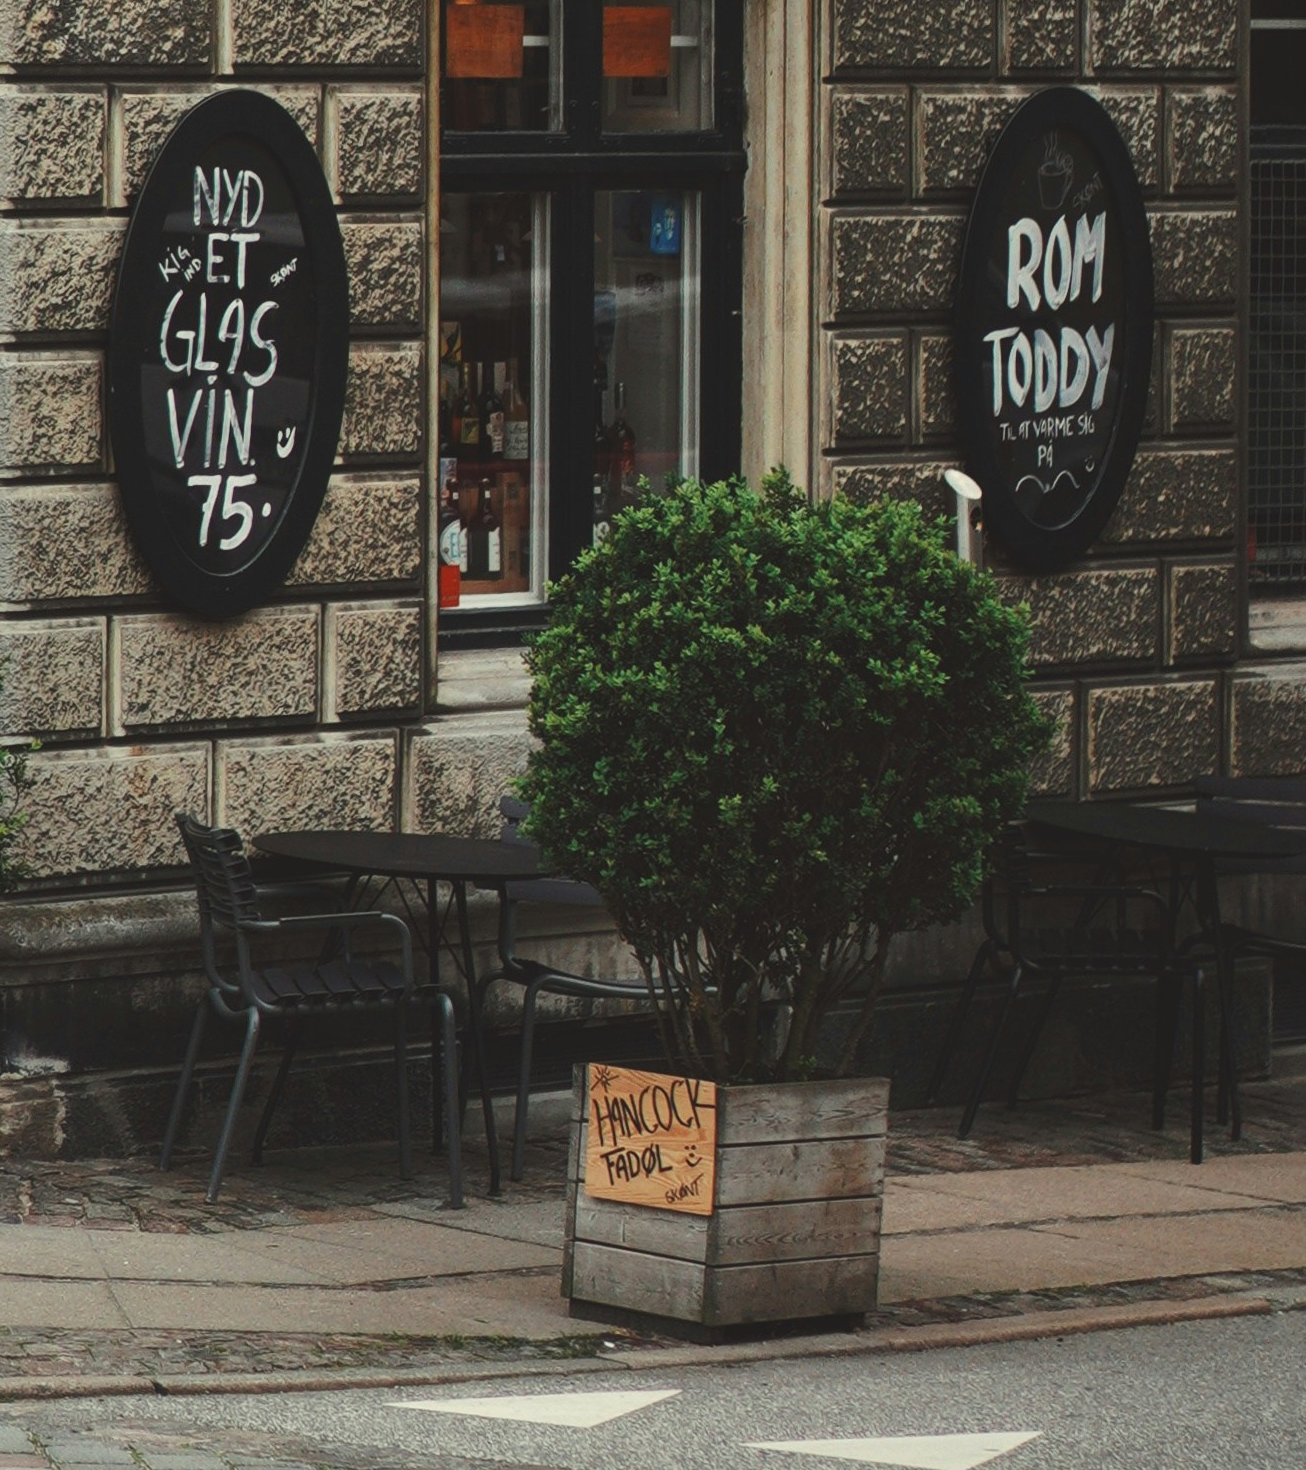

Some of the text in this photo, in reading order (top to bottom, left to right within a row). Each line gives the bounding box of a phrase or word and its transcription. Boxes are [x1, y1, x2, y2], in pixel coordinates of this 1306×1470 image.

[193, 165, 264, 228] NYD
[158, 244, 191, 283] KIG
[206, 232, 261, 291] ET
[1007, 210, 1106, 312] ROM
[160, 289, 280, 388] GLAS
[982, 322, 1115, 418] TODDY
[999, 411, 1095, 441] TIL AT VARME SIG
[592, 1078, 716, 1146] HANCOCK
[600, 1143, 673, 1186] FADØL
[665, 1173, 704, 1204] SKØNT
